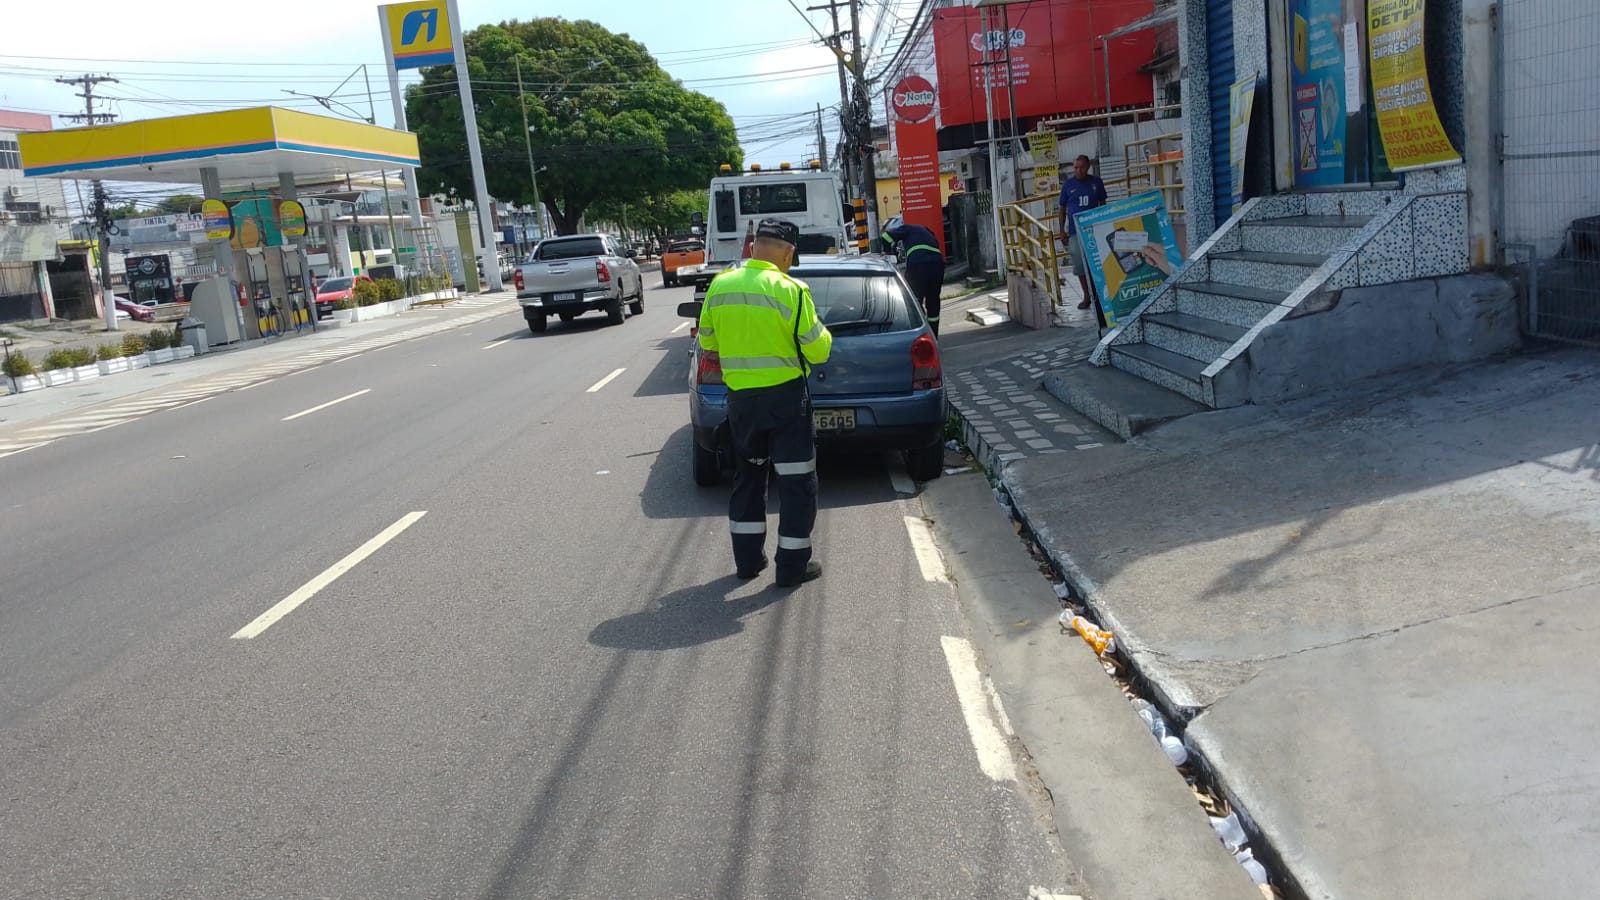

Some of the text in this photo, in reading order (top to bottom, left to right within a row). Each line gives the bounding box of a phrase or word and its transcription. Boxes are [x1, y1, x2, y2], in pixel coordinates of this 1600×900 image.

[906, 91, 932, 102] Norte
[1030, 133, 1053, 141] TEMOS
[1079, 196, 1089, 206] 10
[143, 216, 168, 226] TINTAS
[1121, 287, 1137, 299] VT
